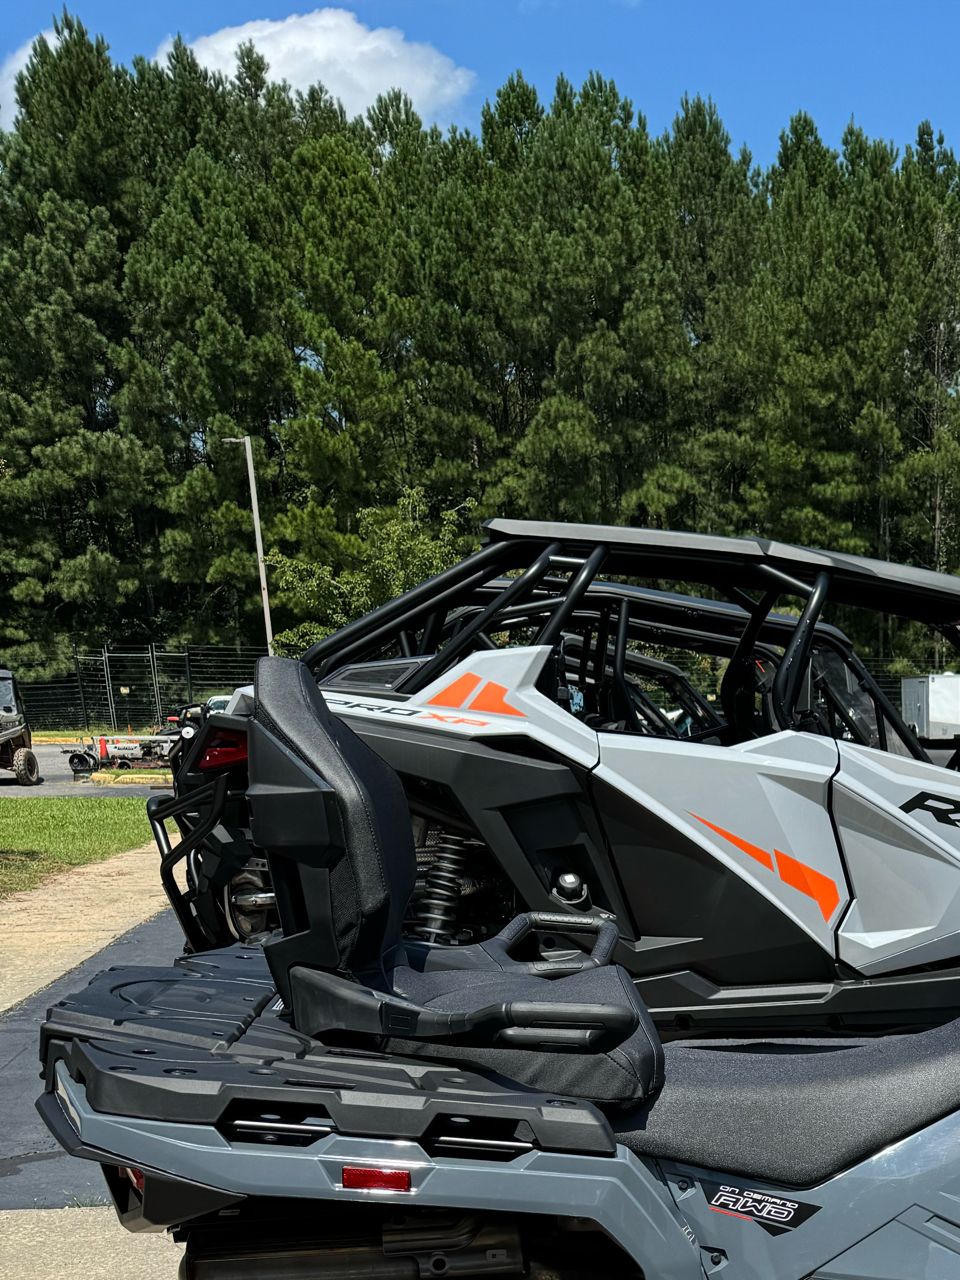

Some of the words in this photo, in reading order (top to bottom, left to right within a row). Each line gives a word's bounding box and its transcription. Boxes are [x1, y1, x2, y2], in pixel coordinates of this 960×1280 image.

[417, 712, 490, 728] XP
[710, 1191, 795, 1222] AWD
[719, 1185, 739, 1195] ON
[743, 1190, 799, 1209] DEMAND
